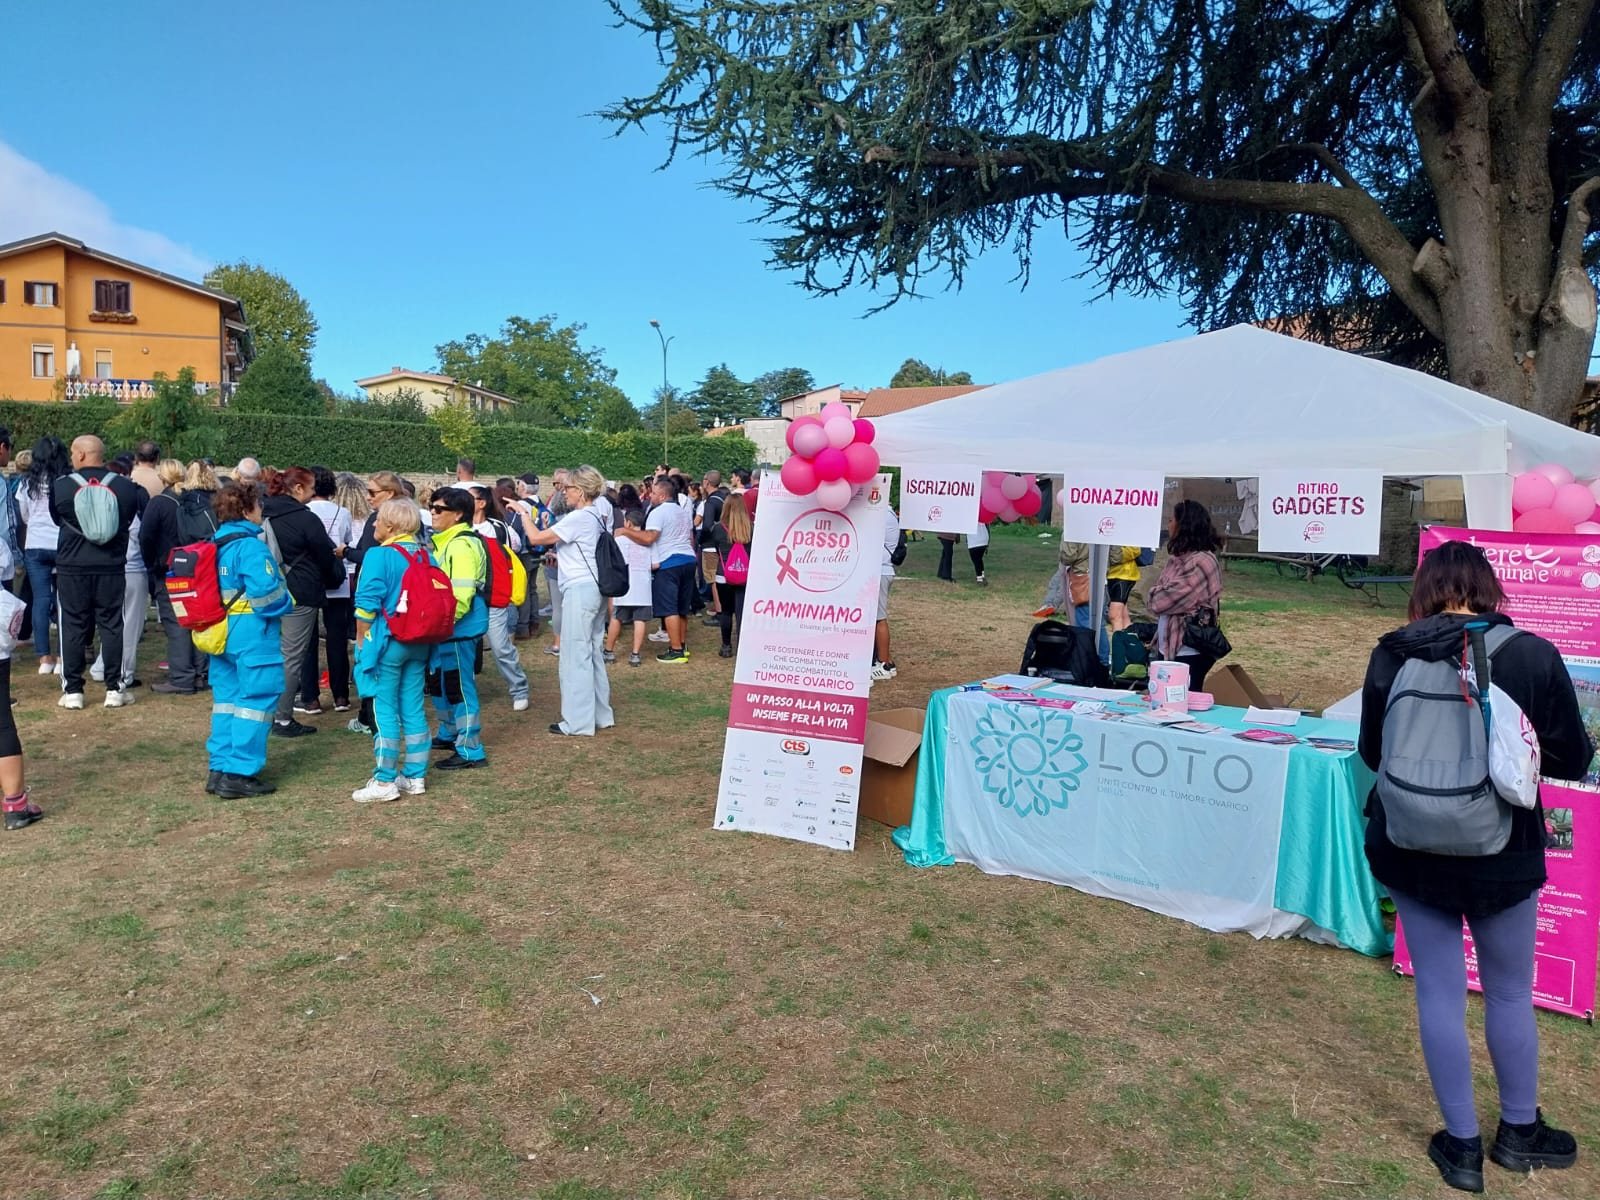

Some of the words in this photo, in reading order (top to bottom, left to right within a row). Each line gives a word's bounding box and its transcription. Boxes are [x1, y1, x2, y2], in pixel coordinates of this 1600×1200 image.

[906, 479, 975, 496] ISCRIZIONI
[1070, 487, 1159, 507] DONAZIONI
[1297, 482, 1339, 495] RITIRO
[1272, 496, 1365, 515] GADGETS
[814, 519, 832, 531] un
[792, 530, 851, 550] passo
[795, 550, 817, 564] alla
[822, 549, 851, 563] volta
[753, 599, 863, 624] CAMMINIAMO
[773, 655, 788, 663] CHE
[788, 656, 838, 668] COMBATTONO
[778, 646, 815, 657] SOSTENERE
[825, 651, 850, 660] DONNE
[769, 663, 794, 672] HANNO
[795, 665, 842, 678] COMBATUTTO
[754, 670, 800, 685] TUMORE
[802, 676, 854, 691] OVARICO
[746, 693, 761, 703] UN
[762, 694, 794, 708] PASSO
[794, 698, 821, 712] ALLA
[823, 702, 855, 716] VOLTA
[752, 708, 790, 721] INSIEME
[791, 713, 810, 726] PER
[811, 715, 824, 727] LA
[827, 717, 849, 730] VITA
[1098, 733, 1253, 793] LOTO
[1097, 777, 1121, 787] UNITI
[1121, 781, 1159, 795] CONTRO
[1160, 789, 1168, 797] IL
[1169, 790, 1206, 804] TUMORE
[1208, 798, 1249, 812] OVARICO
